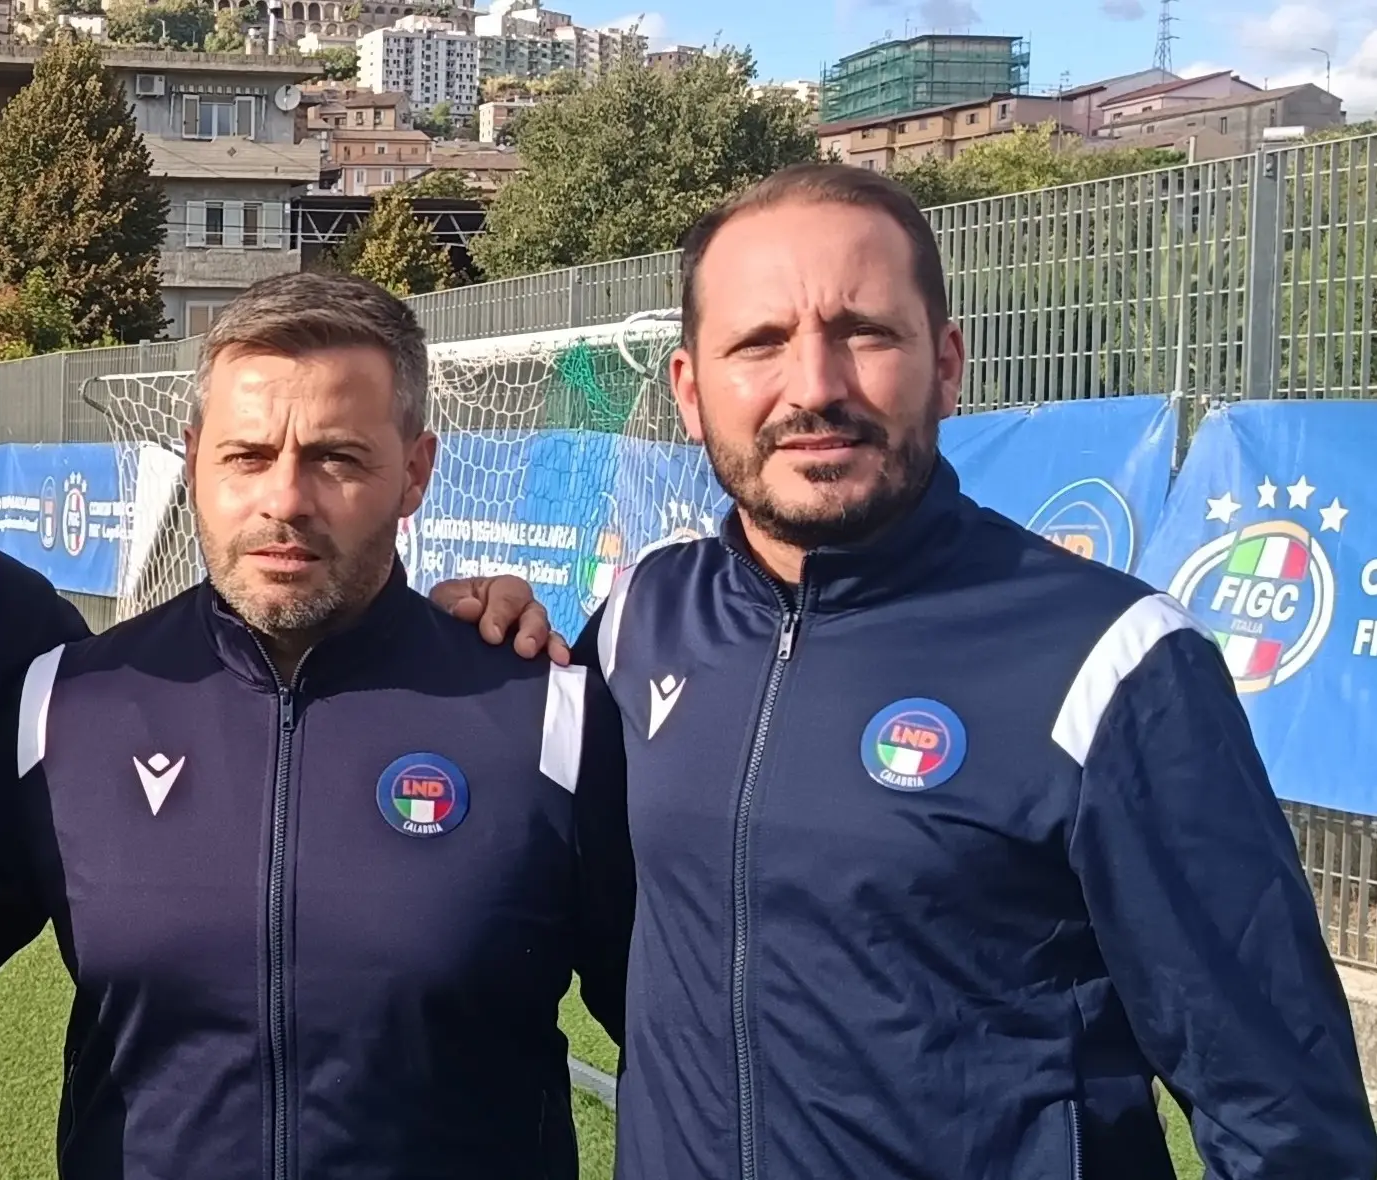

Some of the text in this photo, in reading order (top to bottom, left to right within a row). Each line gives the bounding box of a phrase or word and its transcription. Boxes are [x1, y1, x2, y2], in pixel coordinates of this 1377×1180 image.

[1210, 575, 1299, 622] FIGC
[1230, 619, 1264, 635] ITALIA
[890, 724, 939, 750] LND
[879, 768, 925, 788] CALABRIA
[402, 779, 444, 799] LND
[402, 820, 444, 834] CALABRIA
